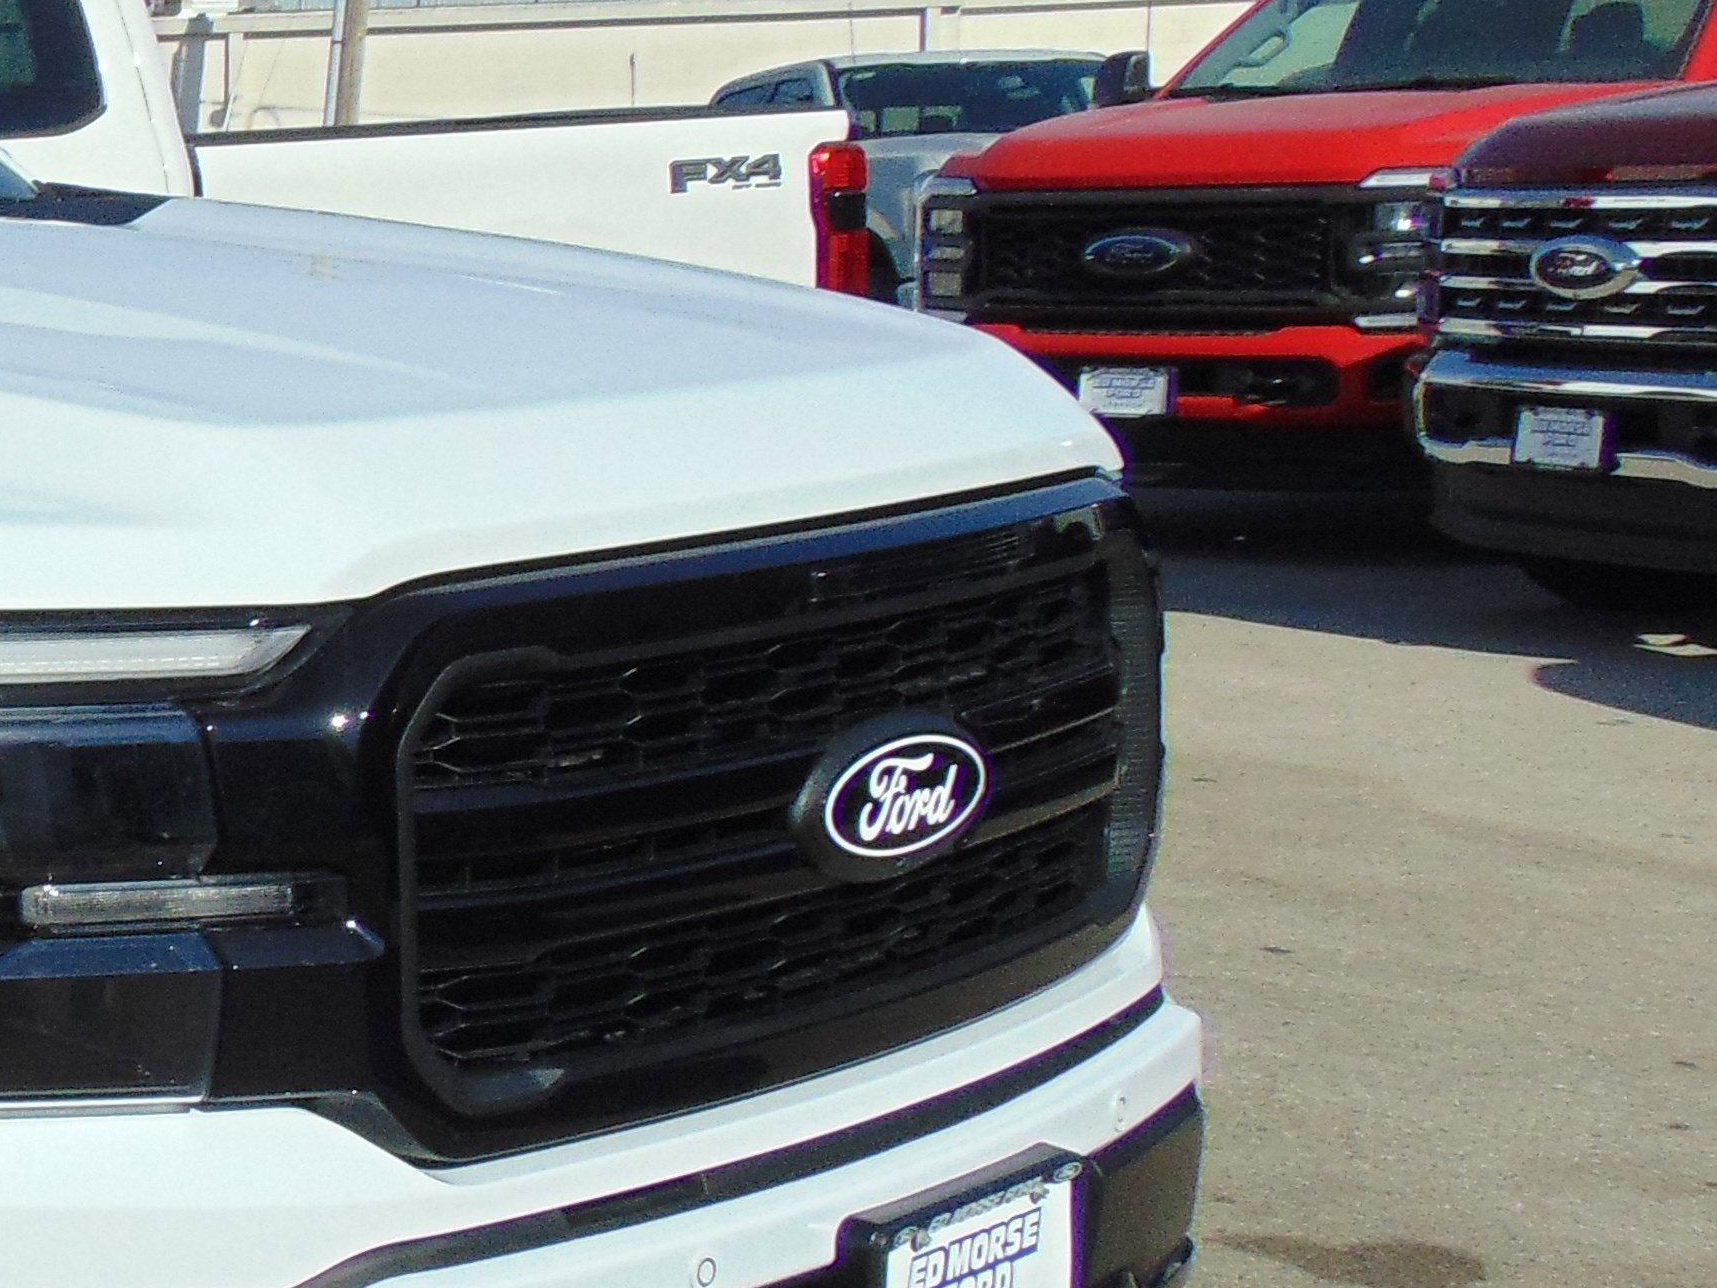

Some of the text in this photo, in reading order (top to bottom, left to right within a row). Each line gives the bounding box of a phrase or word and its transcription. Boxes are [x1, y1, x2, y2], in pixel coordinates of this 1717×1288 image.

[669, 153, 782, 194] FX4
[858, 752, 958, 842] Ford
[946, 1208, 1042, 1282] MORSE
